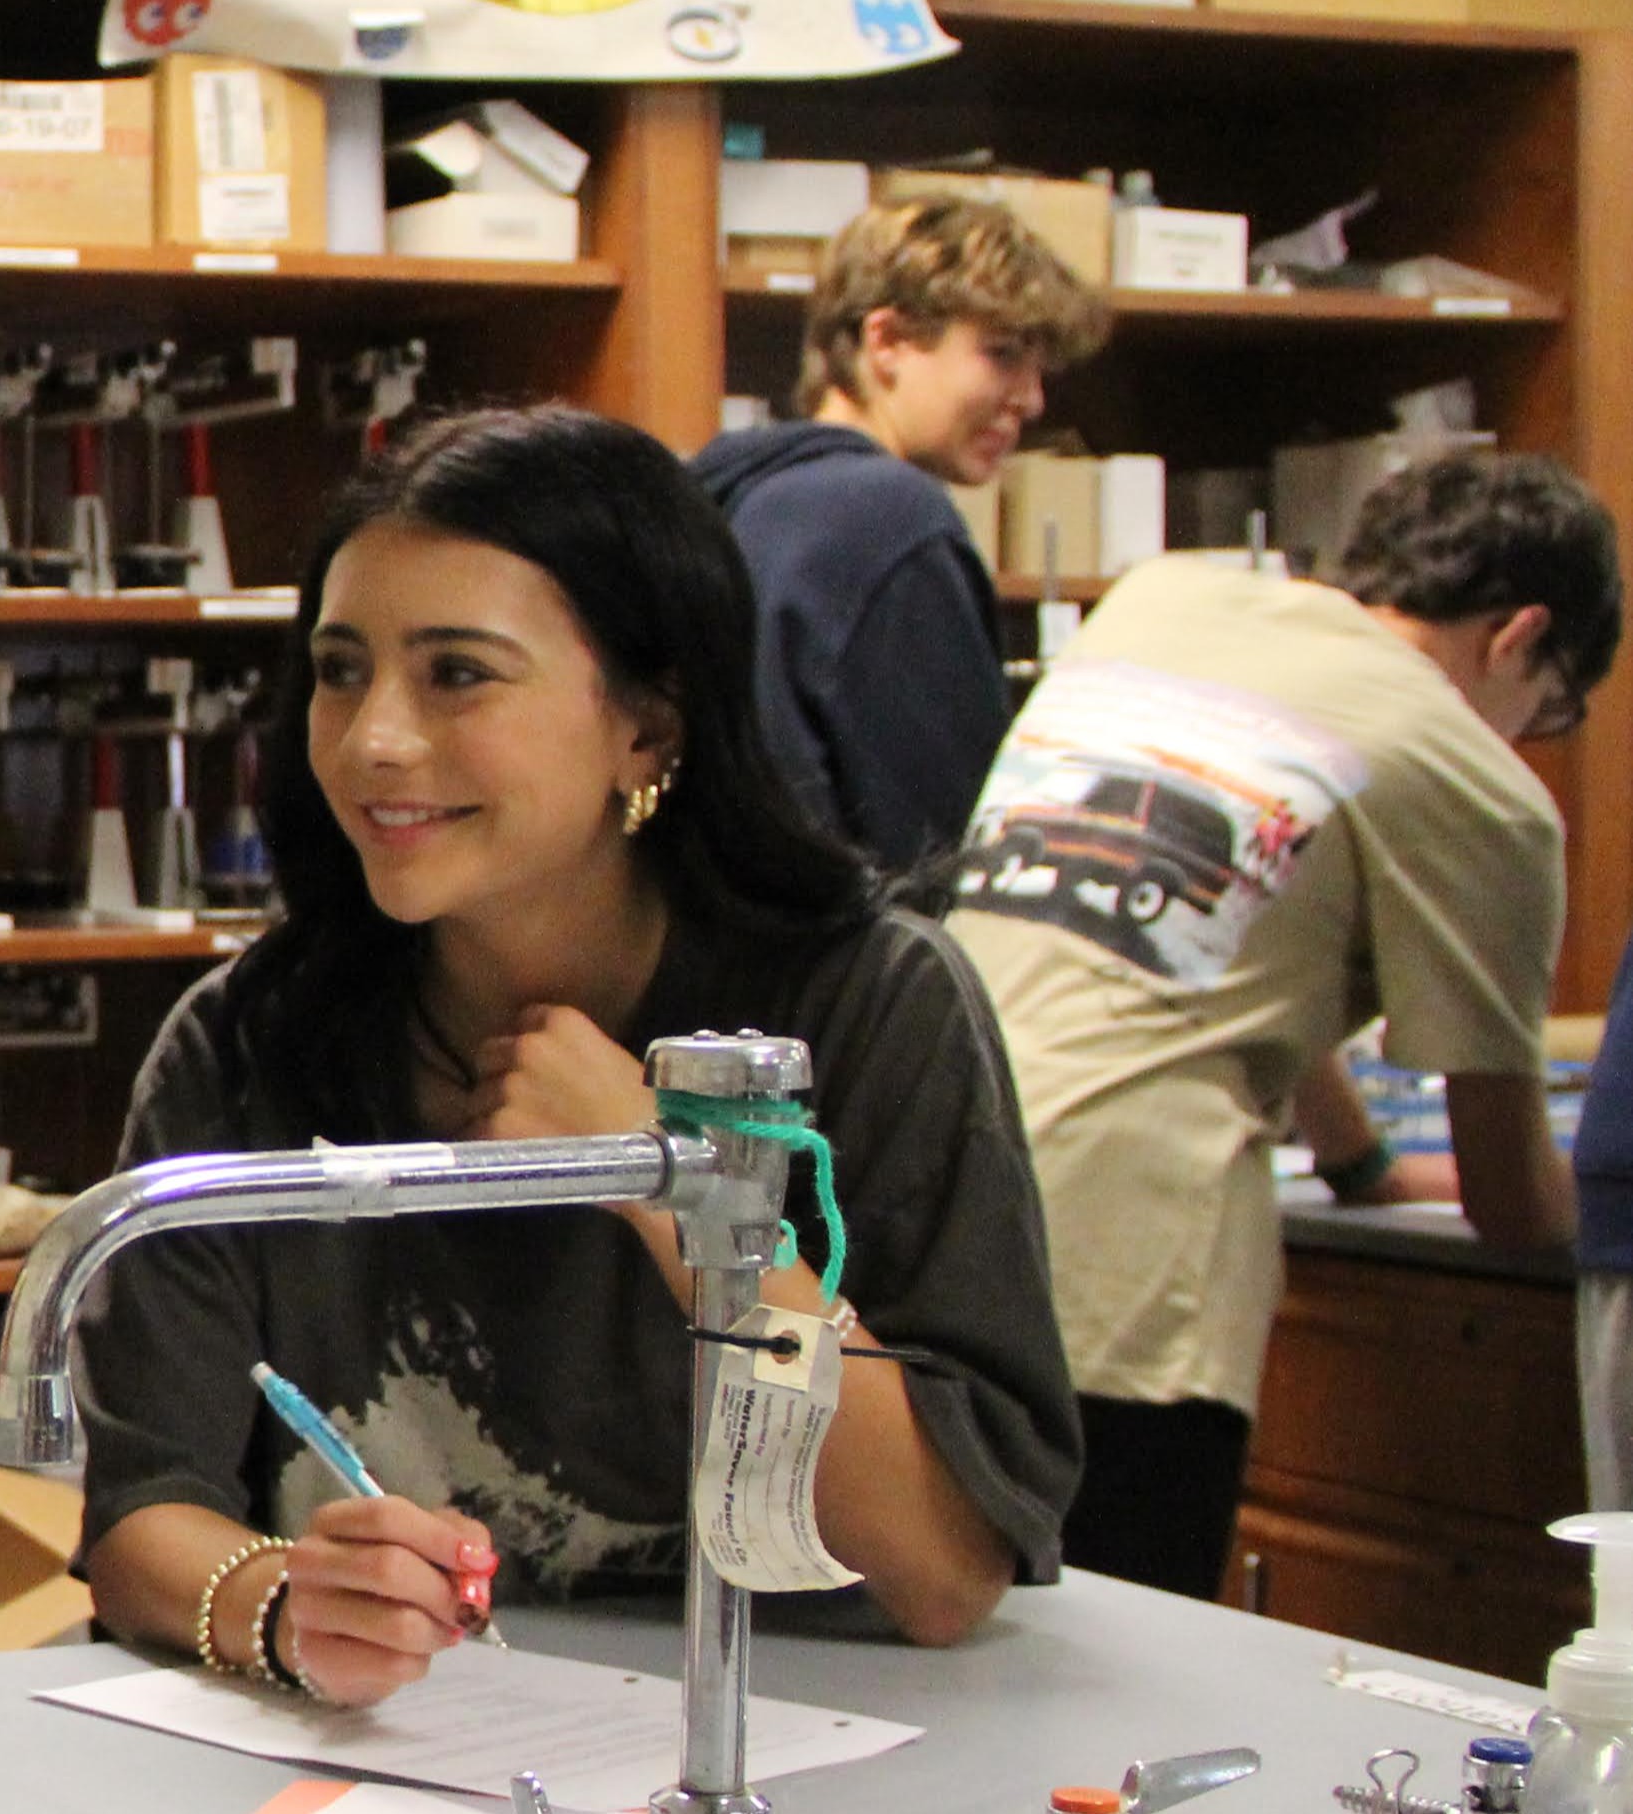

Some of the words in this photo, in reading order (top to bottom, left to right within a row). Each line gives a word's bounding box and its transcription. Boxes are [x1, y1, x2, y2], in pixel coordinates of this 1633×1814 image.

[724, 1389, 755, 1488] WaterSaver
[724, 1492, 740, 1545] Faucet
[734, 1547, 749, 1567] Co.
